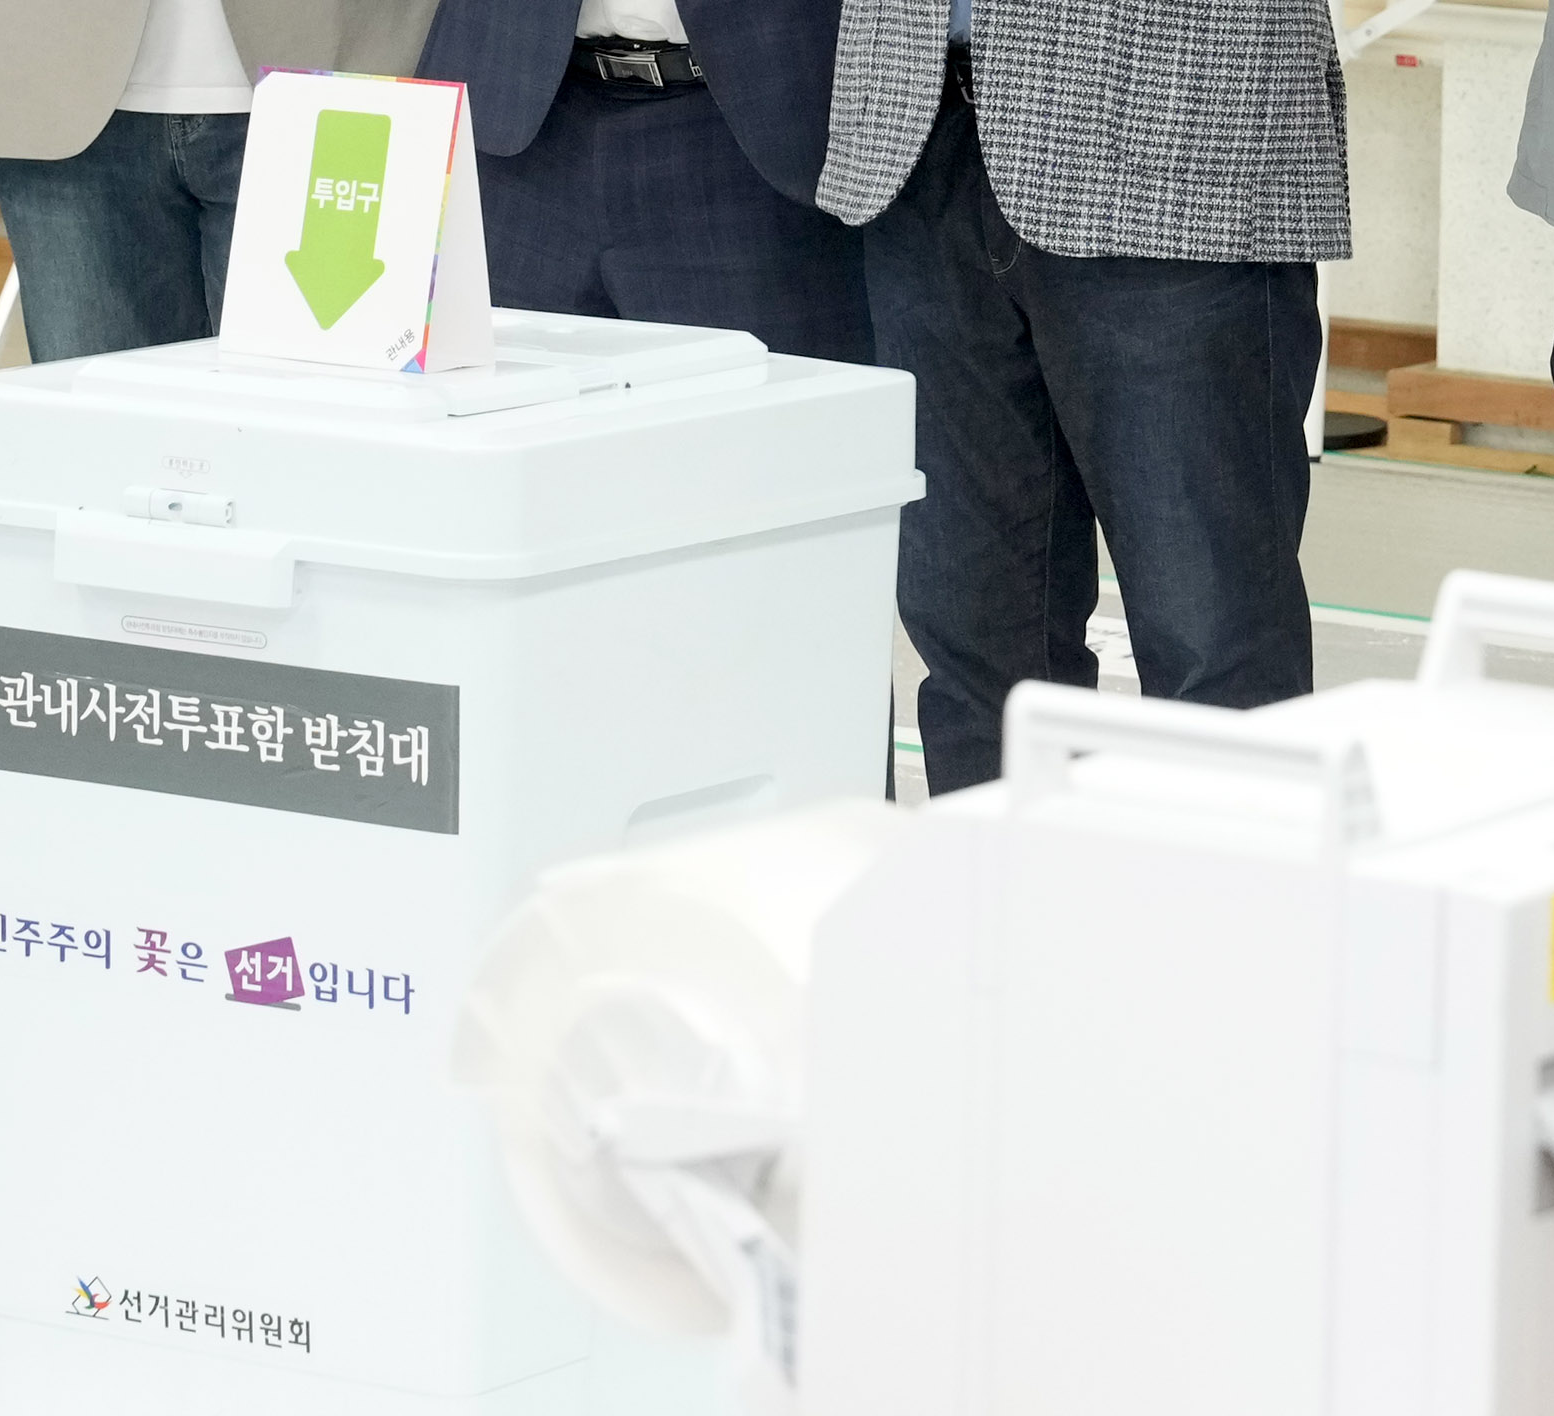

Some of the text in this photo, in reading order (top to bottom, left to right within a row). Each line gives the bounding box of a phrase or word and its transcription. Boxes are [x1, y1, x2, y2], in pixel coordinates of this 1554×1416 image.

[311, 177, 380, 214] 투입구
[385, 328, 416, 362] 관내용
[302, 713, 430, 786] 받침대
[133, 926, 209, 983] 꽃은
[118, 1288, 312, 1354] 선거관리위원회
